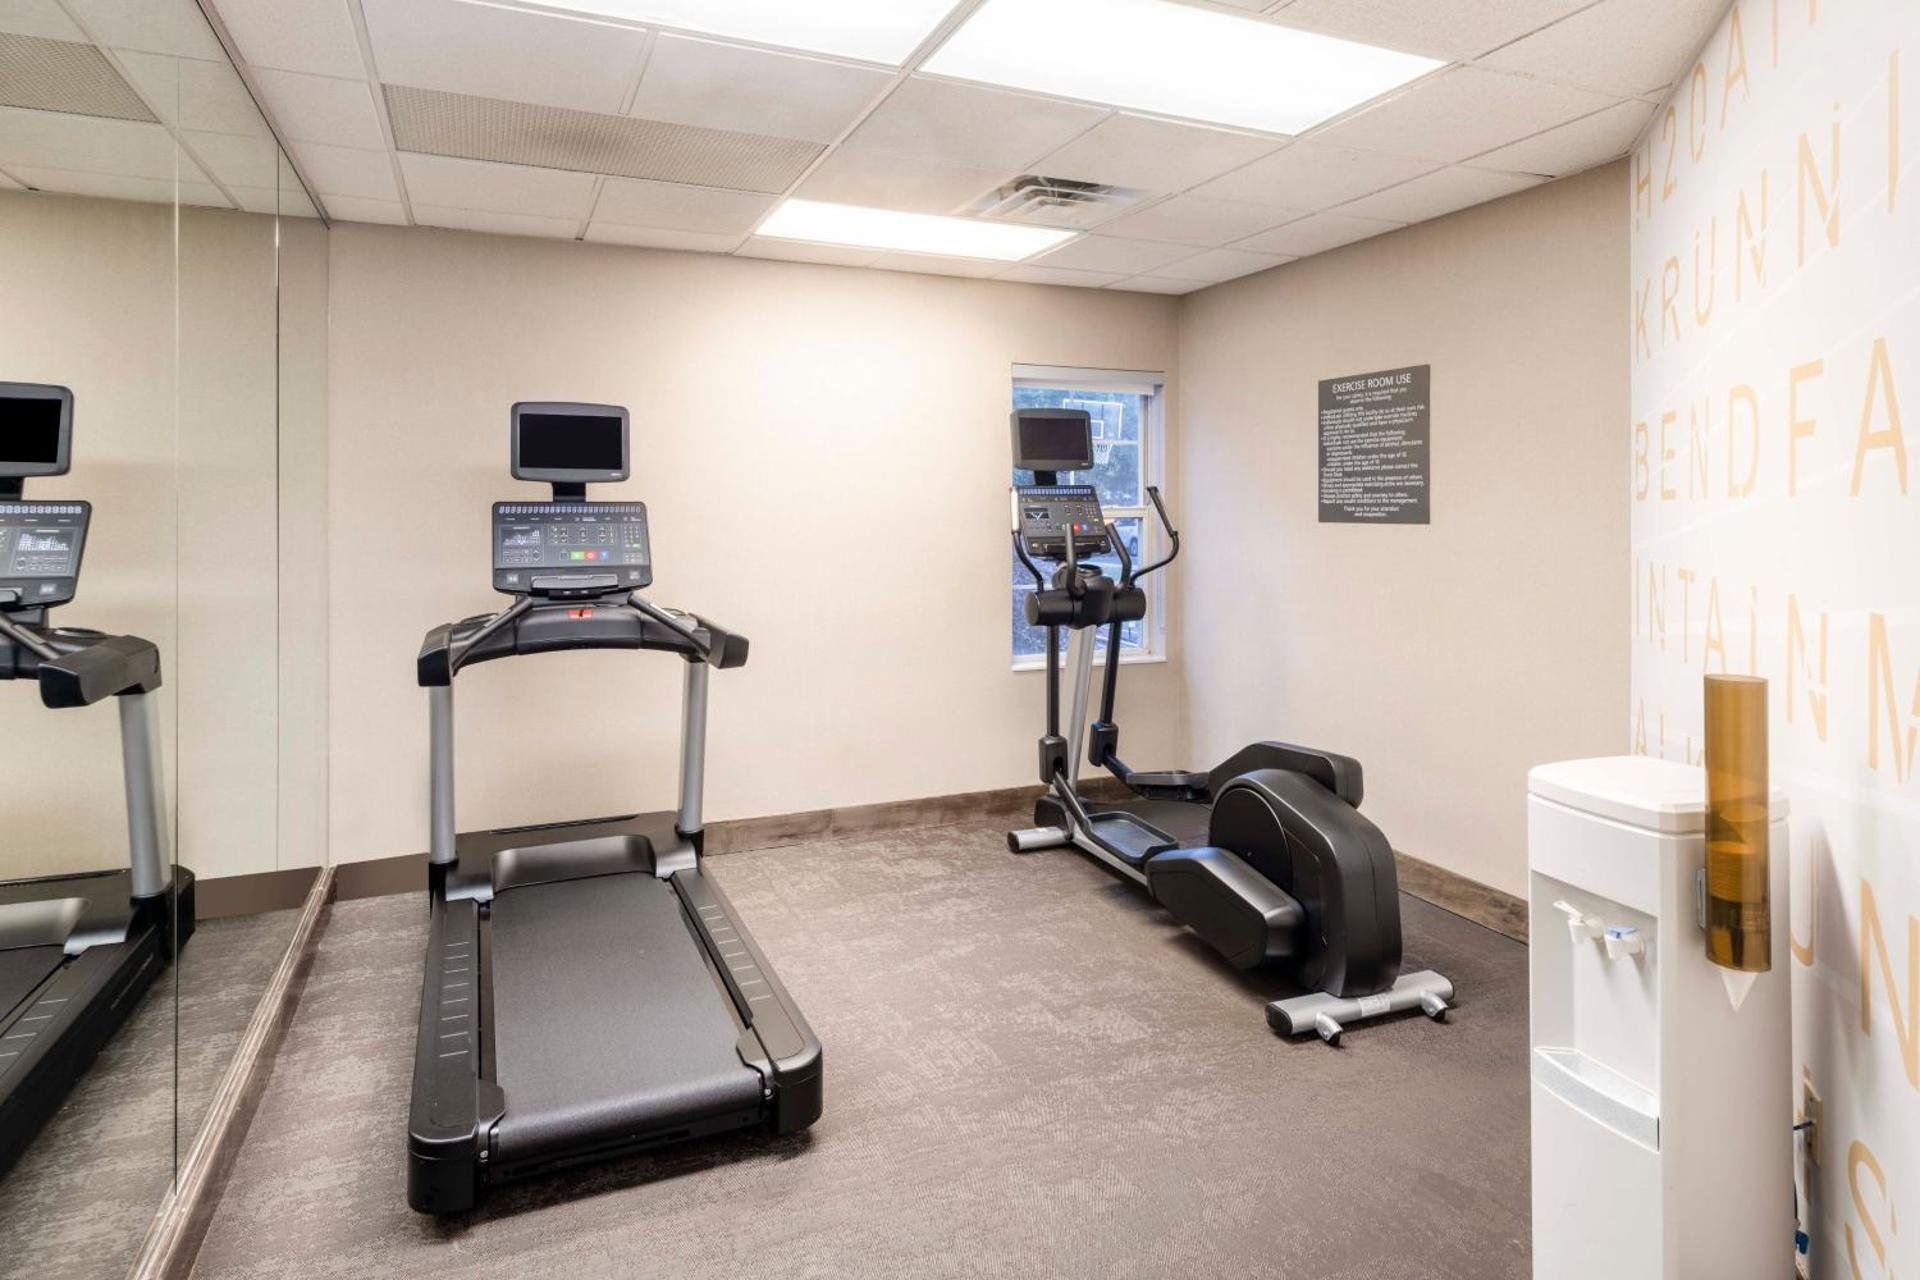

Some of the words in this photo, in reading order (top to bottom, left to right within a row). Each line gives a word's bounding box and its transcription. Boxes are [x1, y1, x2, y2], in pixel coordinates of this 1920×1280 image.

[1332, 380, 1366, 394] EXERCISE
[1367, 376, 1394, 389] ROOM
[1396, 373, 1412, 385] USE
